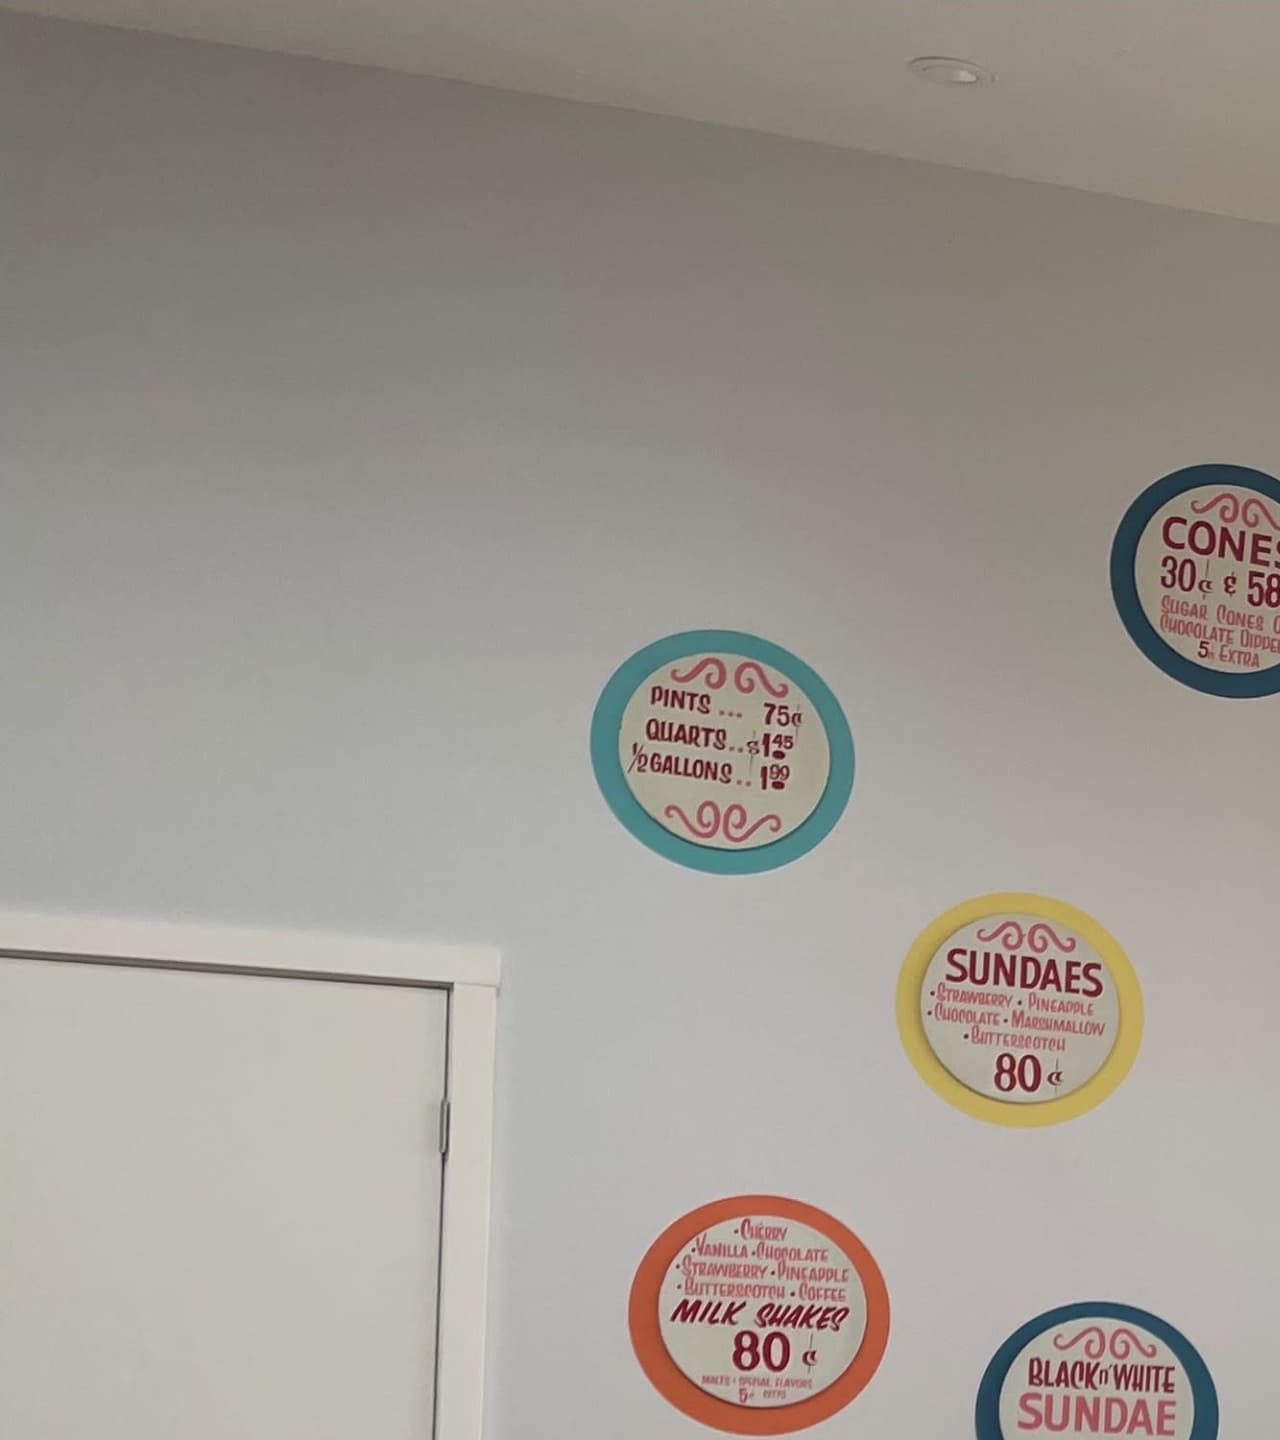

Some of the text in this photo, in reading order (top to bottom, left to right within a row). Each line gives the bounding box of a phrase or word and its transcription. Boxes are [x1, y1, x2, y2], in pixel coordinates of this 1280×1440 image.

[1161, 595, 1207, 619] SUGAR
[1216, 605, 1264, 631] CONES
[1160, 614, 1234, 644] CHOCOLATE
[1219, 645, 1259, 668] EXTRA
[651, 686, 711, 715] PINTS
[645, 719, 727, 751] QUARTS
[650, 753, 732, 784] GALLONS
[945, 948, 1103, 998] SUNDAES
[937, 982, 1094, 1016] STRAWBERRY PINEAPPLE
[934, 1004, 1105, 1036] CHOCOLATE MARSHMALLOW
[971, 1026, 1066, 1051] BUTTERSCOTCH
[741, 1219, 788, 1241] CHERRY
[695, 1233, 828, 1262] VANILLA CHOCOLATE
[682, 1255, 849, 1282] STRAWBERRY PINEAPPLE
[684, 1277, 846, 1301] BUTTERSCOTCH COFFEE
[671, 1299, 850, 1332] MILK SHAKES
[1028, 1357, 1098, 1390] BLACK
[1113, 1365, 1176, 1394] WHITE
[1017, 1392, 1176, 1436] SUNDAE
